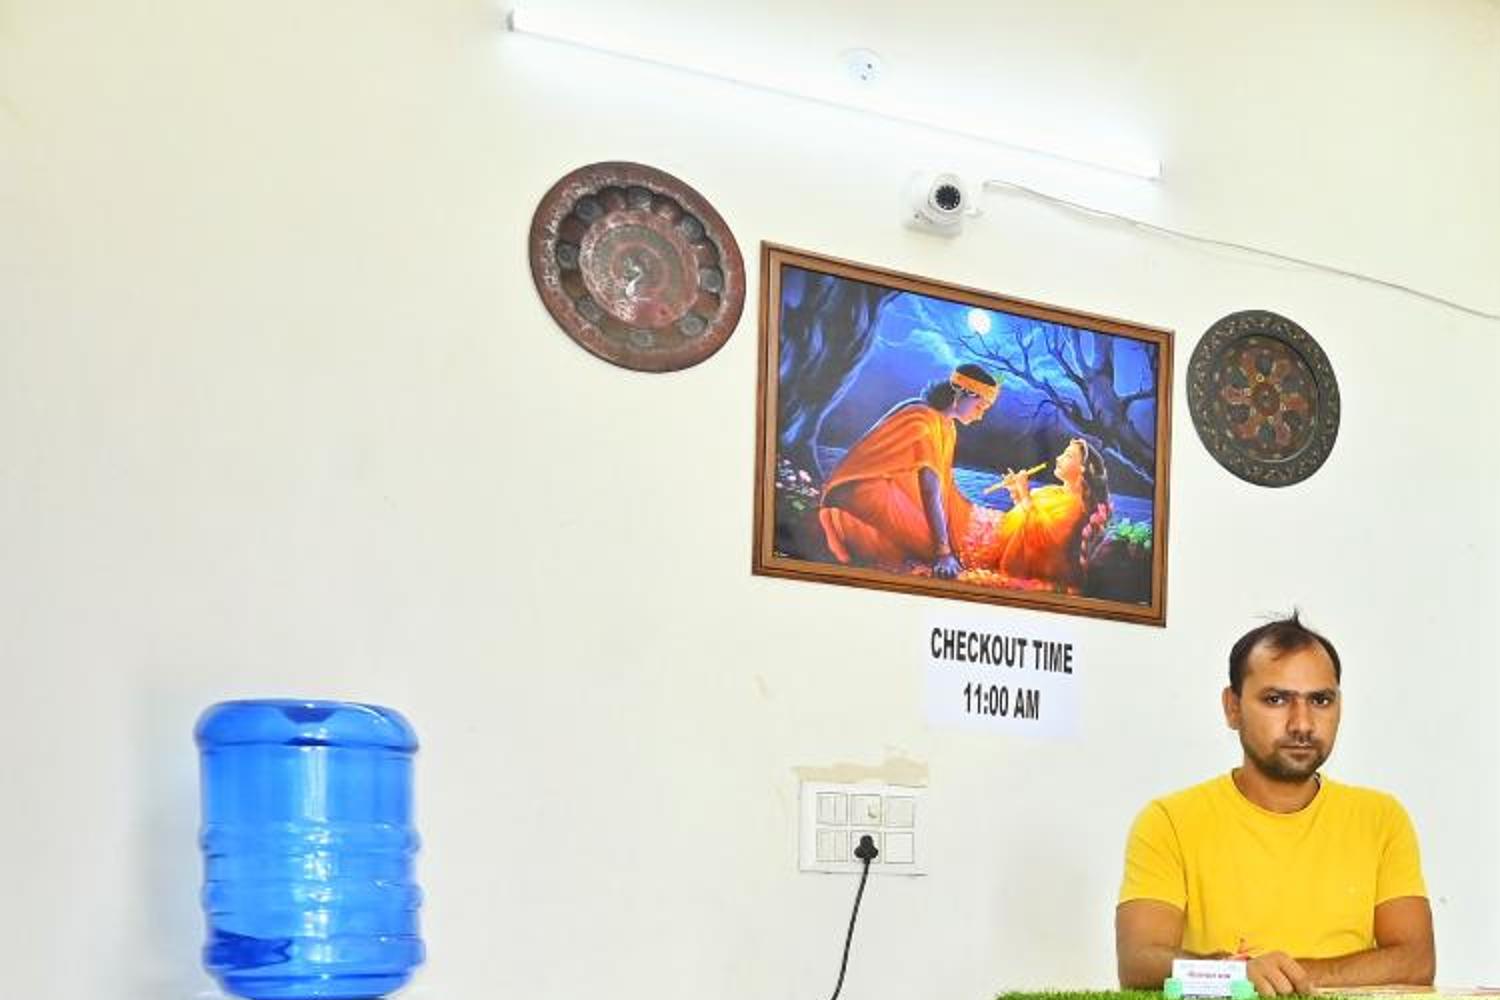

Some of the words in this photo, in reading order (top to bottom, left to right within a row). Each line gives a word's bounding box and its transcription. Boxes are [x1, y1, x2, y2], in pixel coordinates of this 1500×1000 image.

[930, 627, 1027, 669] CHECKOUT
[1032, 639, 1073, 675] TIME
[963, 682, 1009, 717] 11:00
[1013, 687, 1040, 721] AM
